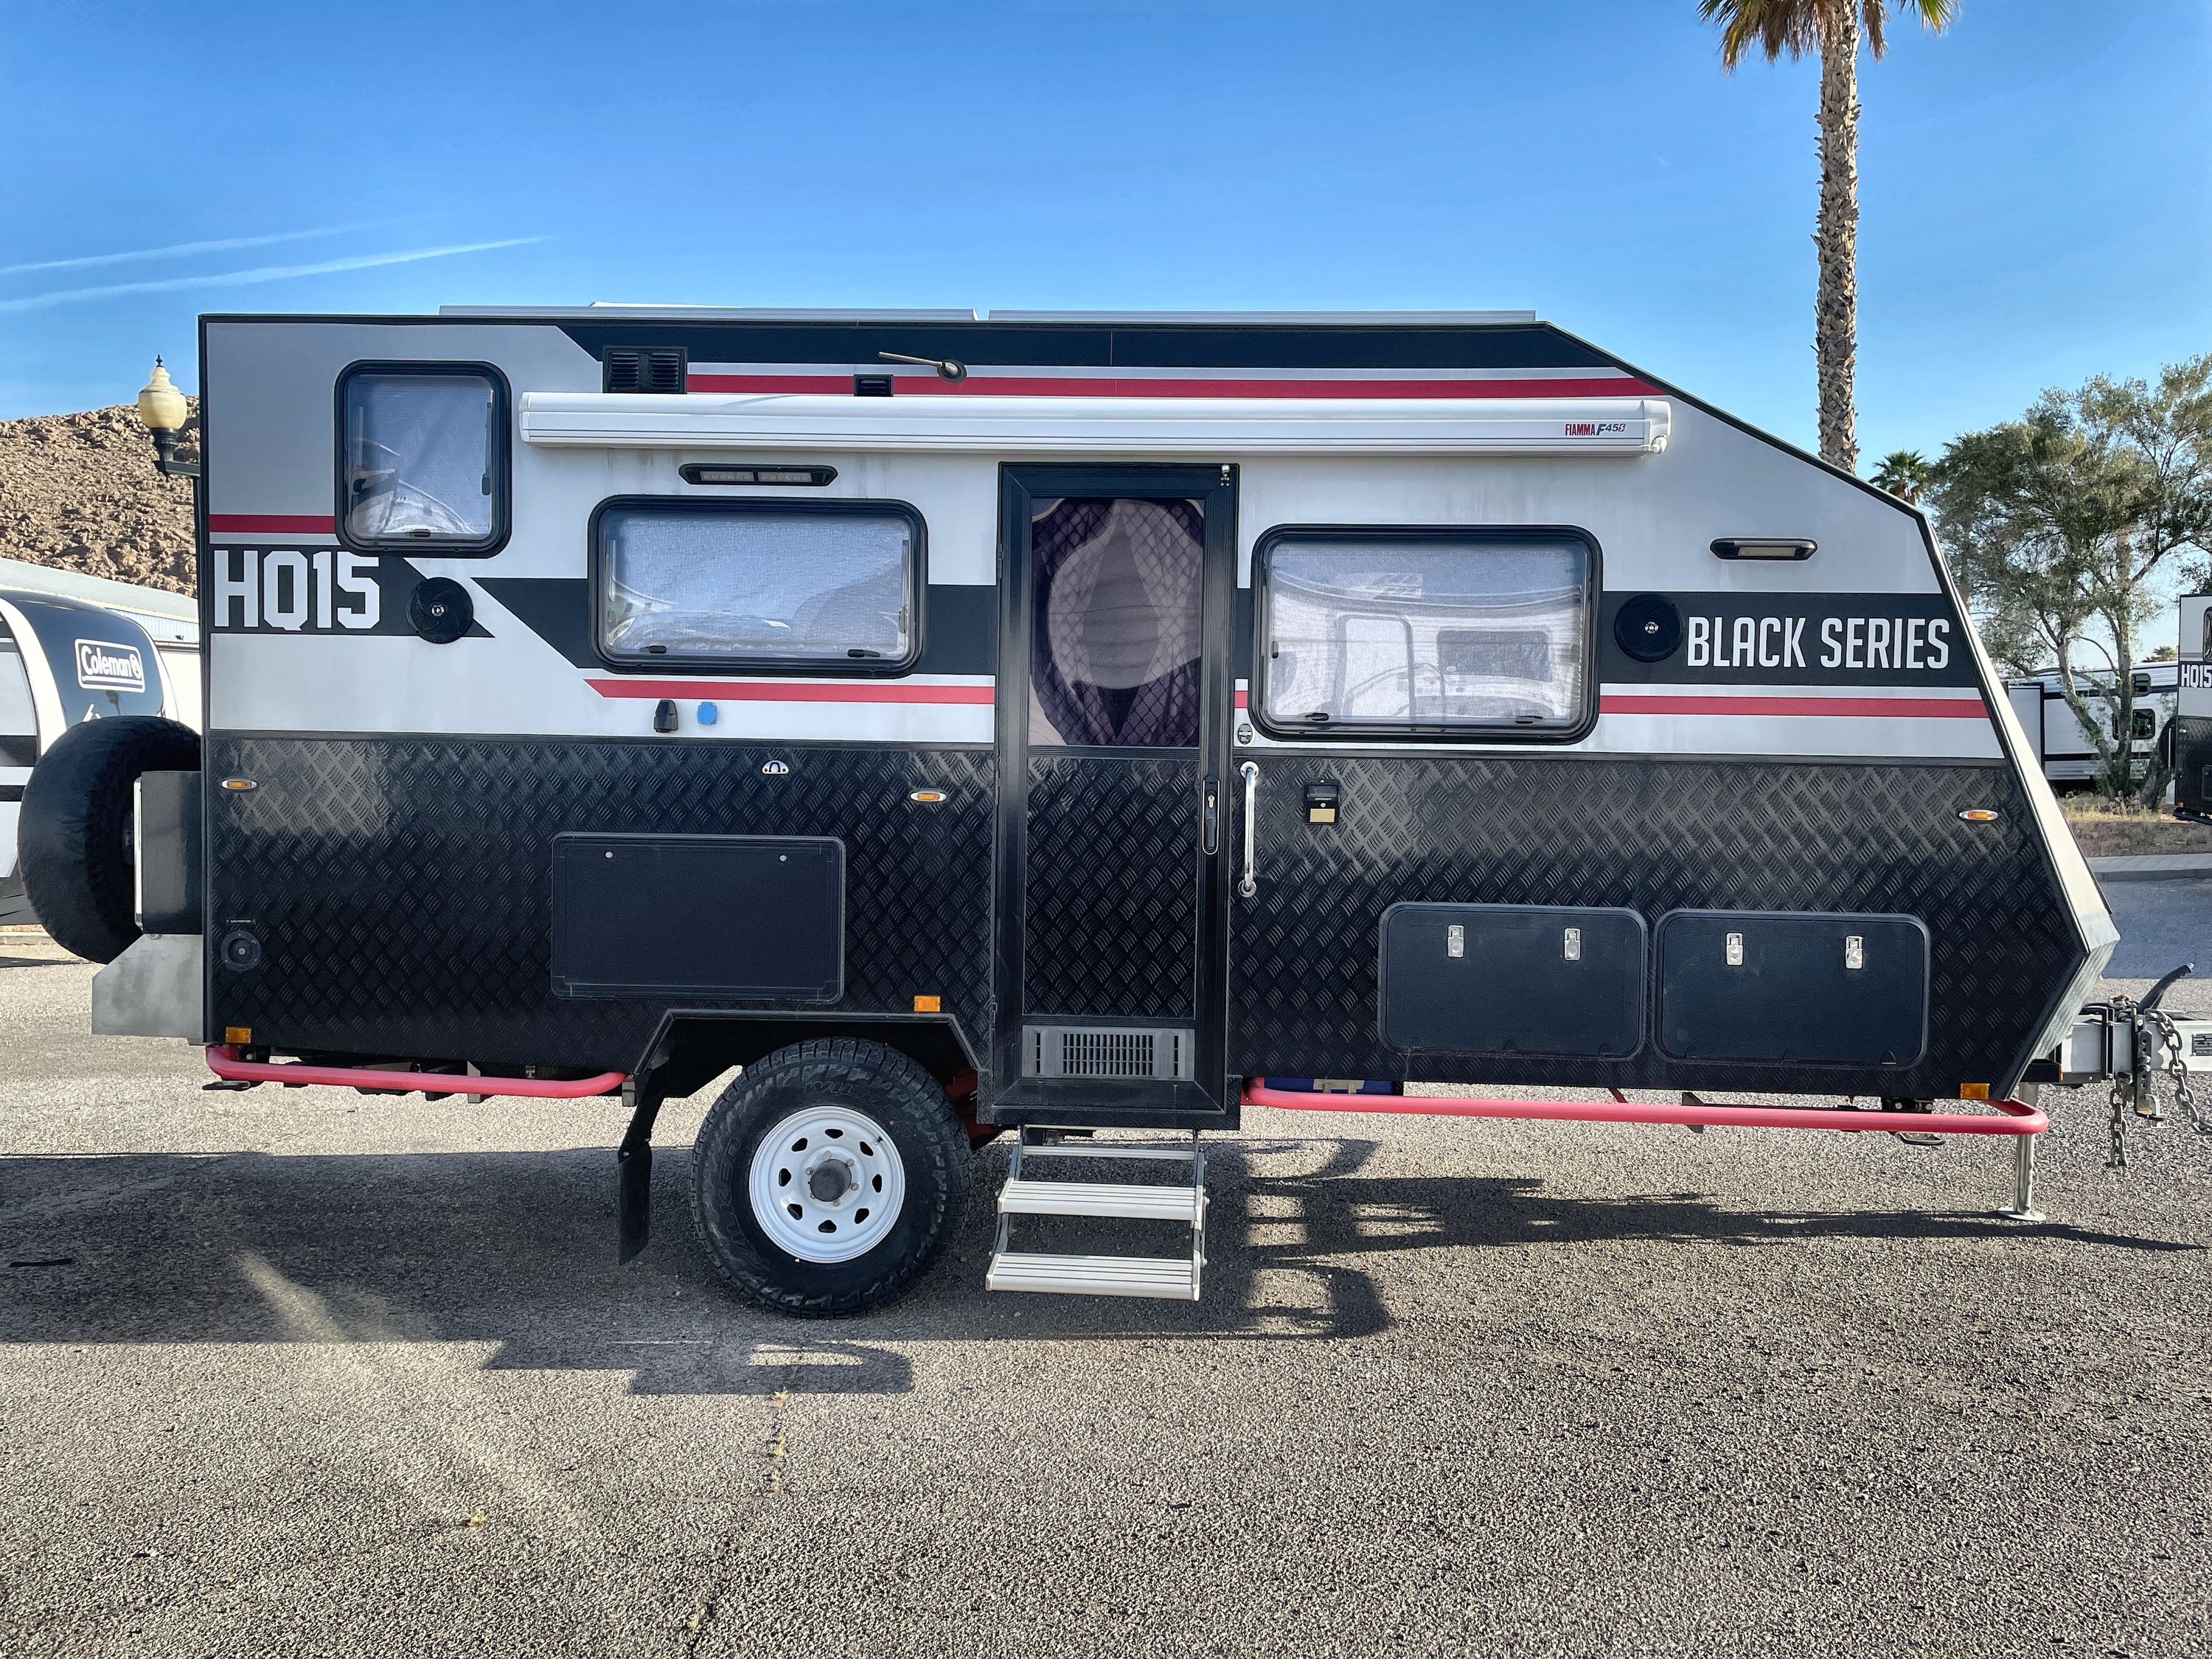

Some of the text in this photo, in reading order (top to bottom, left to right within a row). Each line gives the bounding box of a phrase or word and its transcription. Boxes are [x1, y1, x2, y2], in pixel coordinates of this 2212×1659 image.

[1565, 423, 1596, 436] FIAMMA
[214, 549, 380, 631] HQ15
[1687, 616, 1950, 669] BLACK SERIES
[80, 644, 133, 678] Coleman
[2181, 664, 2212, 688] HQ15
